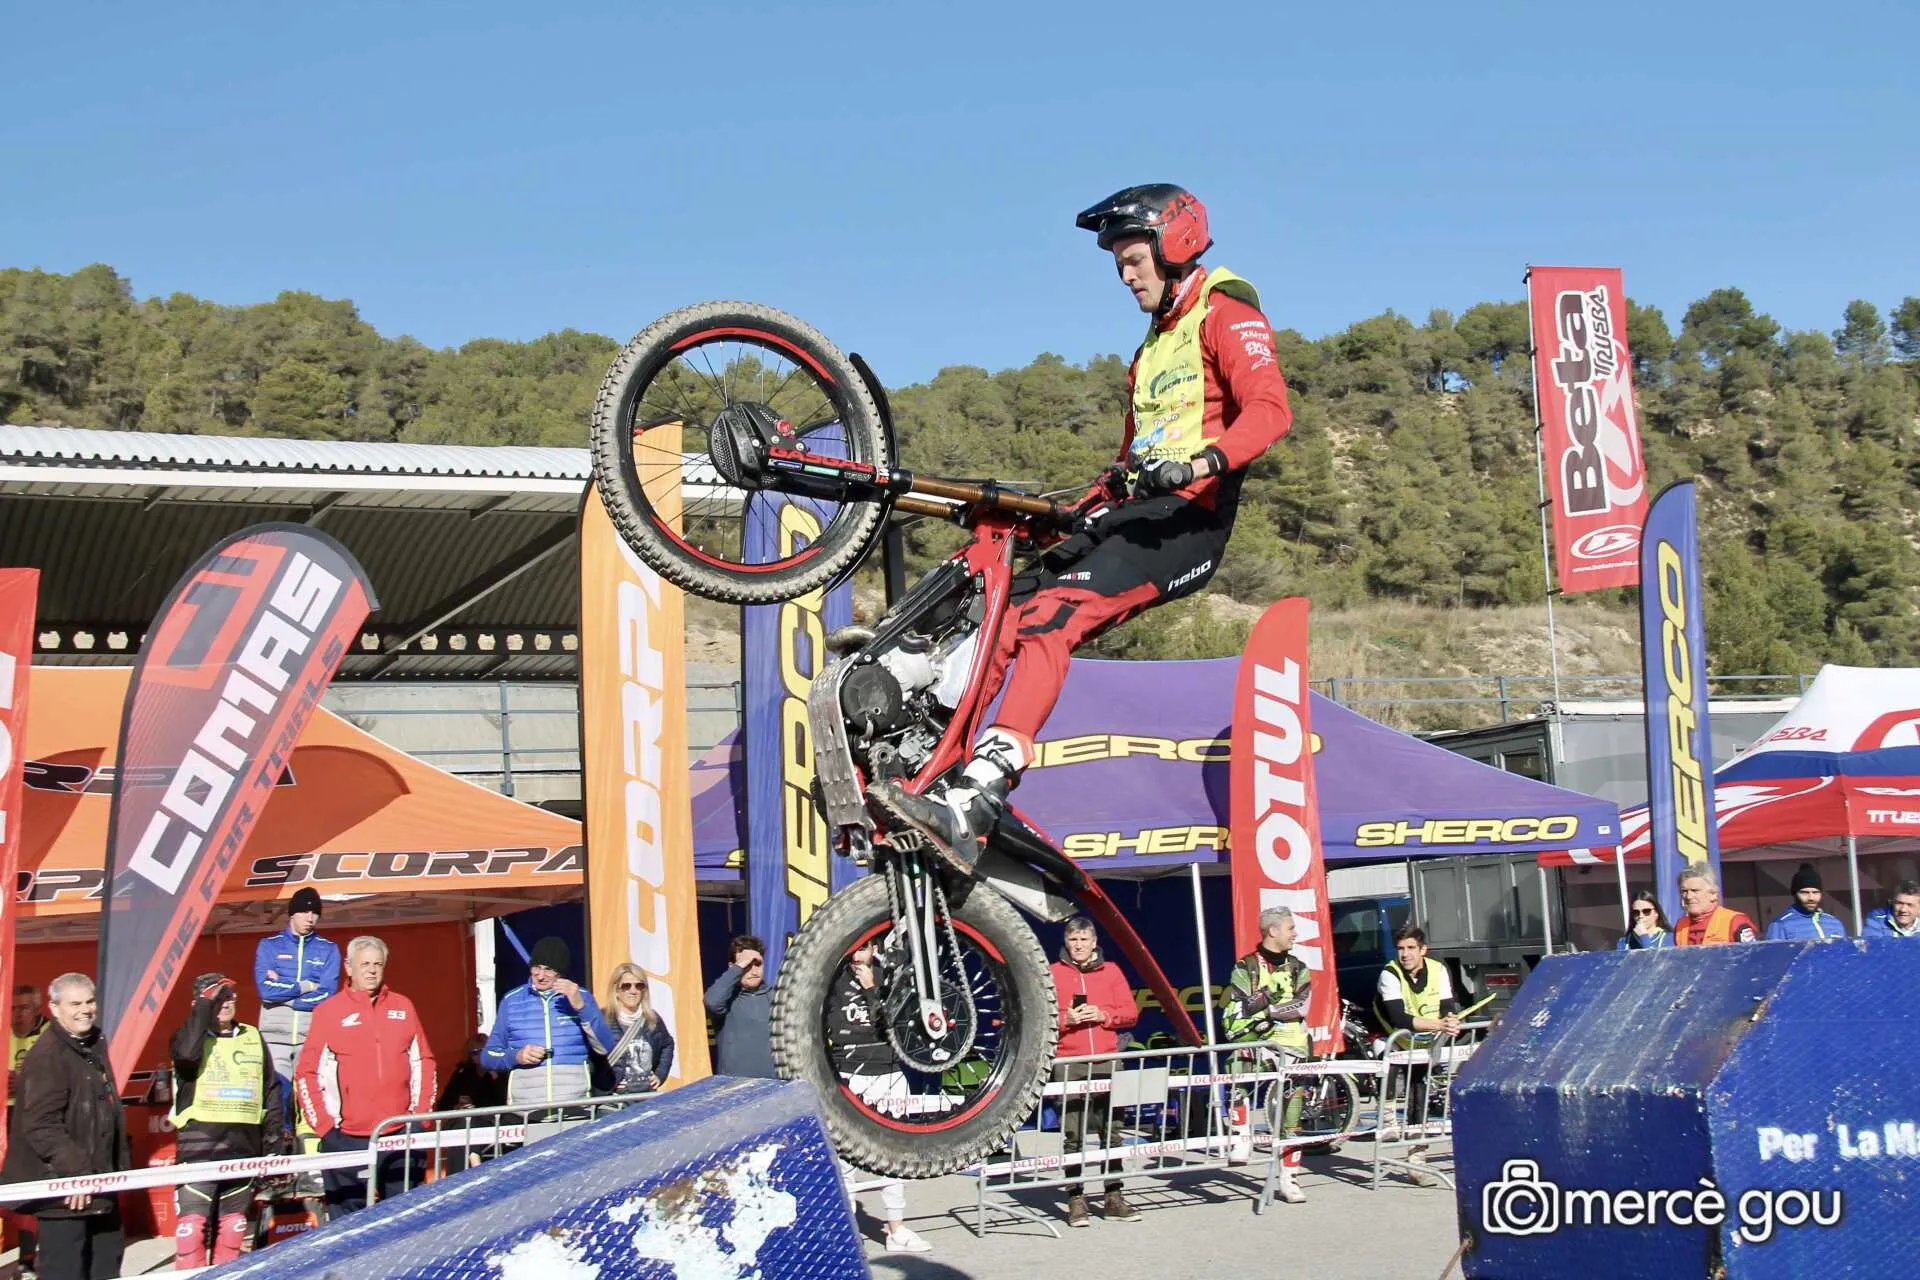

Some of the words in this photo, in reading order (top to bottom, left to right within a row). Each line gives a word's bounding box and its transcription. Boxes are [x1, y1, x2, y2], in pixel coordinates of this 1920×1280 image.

[1554, 291, 1609, 515] Beta
[1168, 560, 1211, 592] hebo
[1658, 541, 1708, 866] ERCO
[128, 552, 342, 895] COMAS
[139, 905, 200, 1017] TIME
[200, 803, 254, 898] FOR
[252, 634, 344, 791] TRIALS
[1063, 825, 1231, 858] SHER
[1354, 815, 1579, 848] SHERCO
[387, 1009, 406, 1020] 93
[1757, 1126, 1819, 1162] Per
[1837, 1123, 1882, 1158] La
[1883, 1119, 1920, 1157] M
[218, 1157, 291, 1177] octagon
[48, 1174, 128, 1194] octagon
